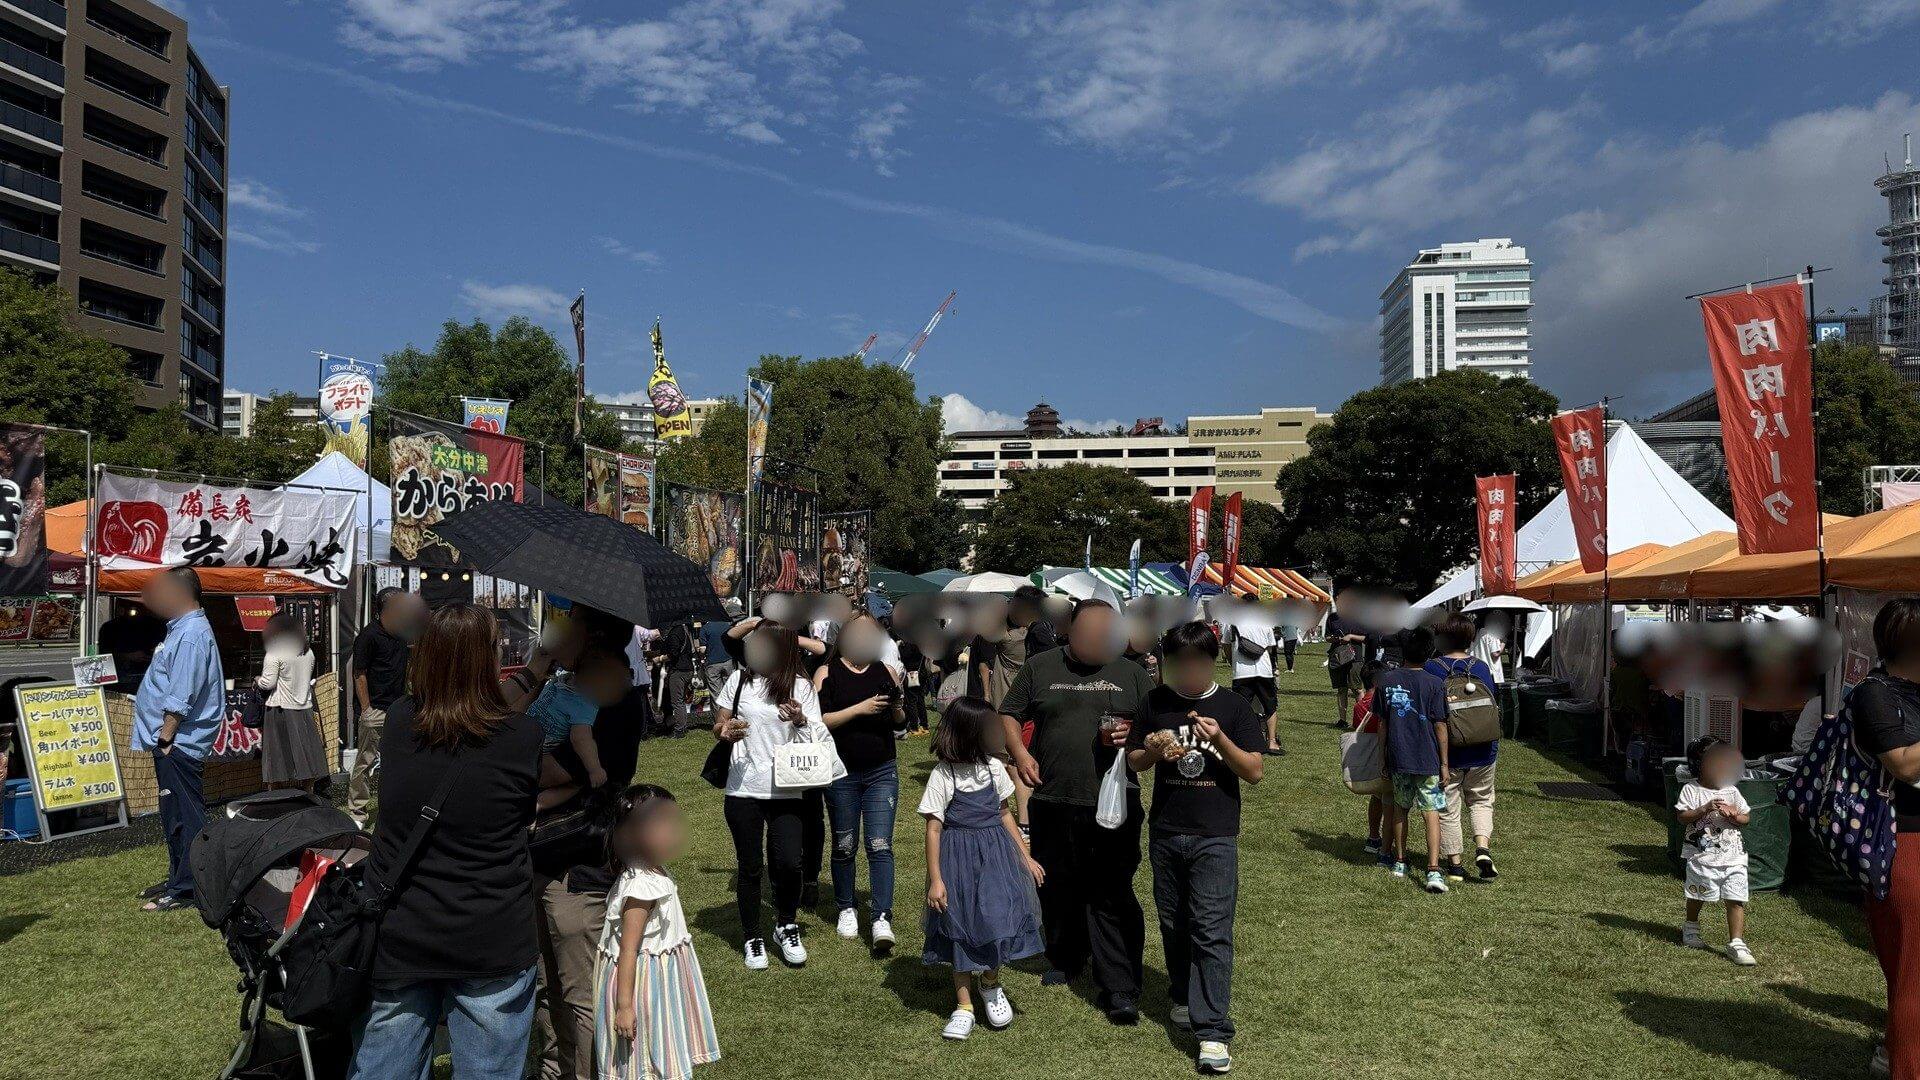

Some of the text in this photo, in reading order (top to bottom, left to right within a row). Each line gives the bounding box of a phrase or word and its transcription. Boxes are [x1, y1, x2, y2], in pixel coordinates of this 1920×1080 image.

[325, 383, 370, 399] フライド
[333, 397, 366, 411] ポテト
[657, 420, 690, 435] OPEN
[433, 446, 489, 474] 大分中津
[177, 490, 254, 524] 備長炭
[180, 519, 349, 585] 炭火焼
[39, 729, 57, 737] Beer
[70, 721, 103, 734] ¥500
[38, 736, 99, 754] 角ハイボール
[78, 752, 110, 765] ¥400
[43, 762, 73, 772] Highball
[45, 777, 76, 790] ラムネ
[83, 782, 116, 796] ¥300
